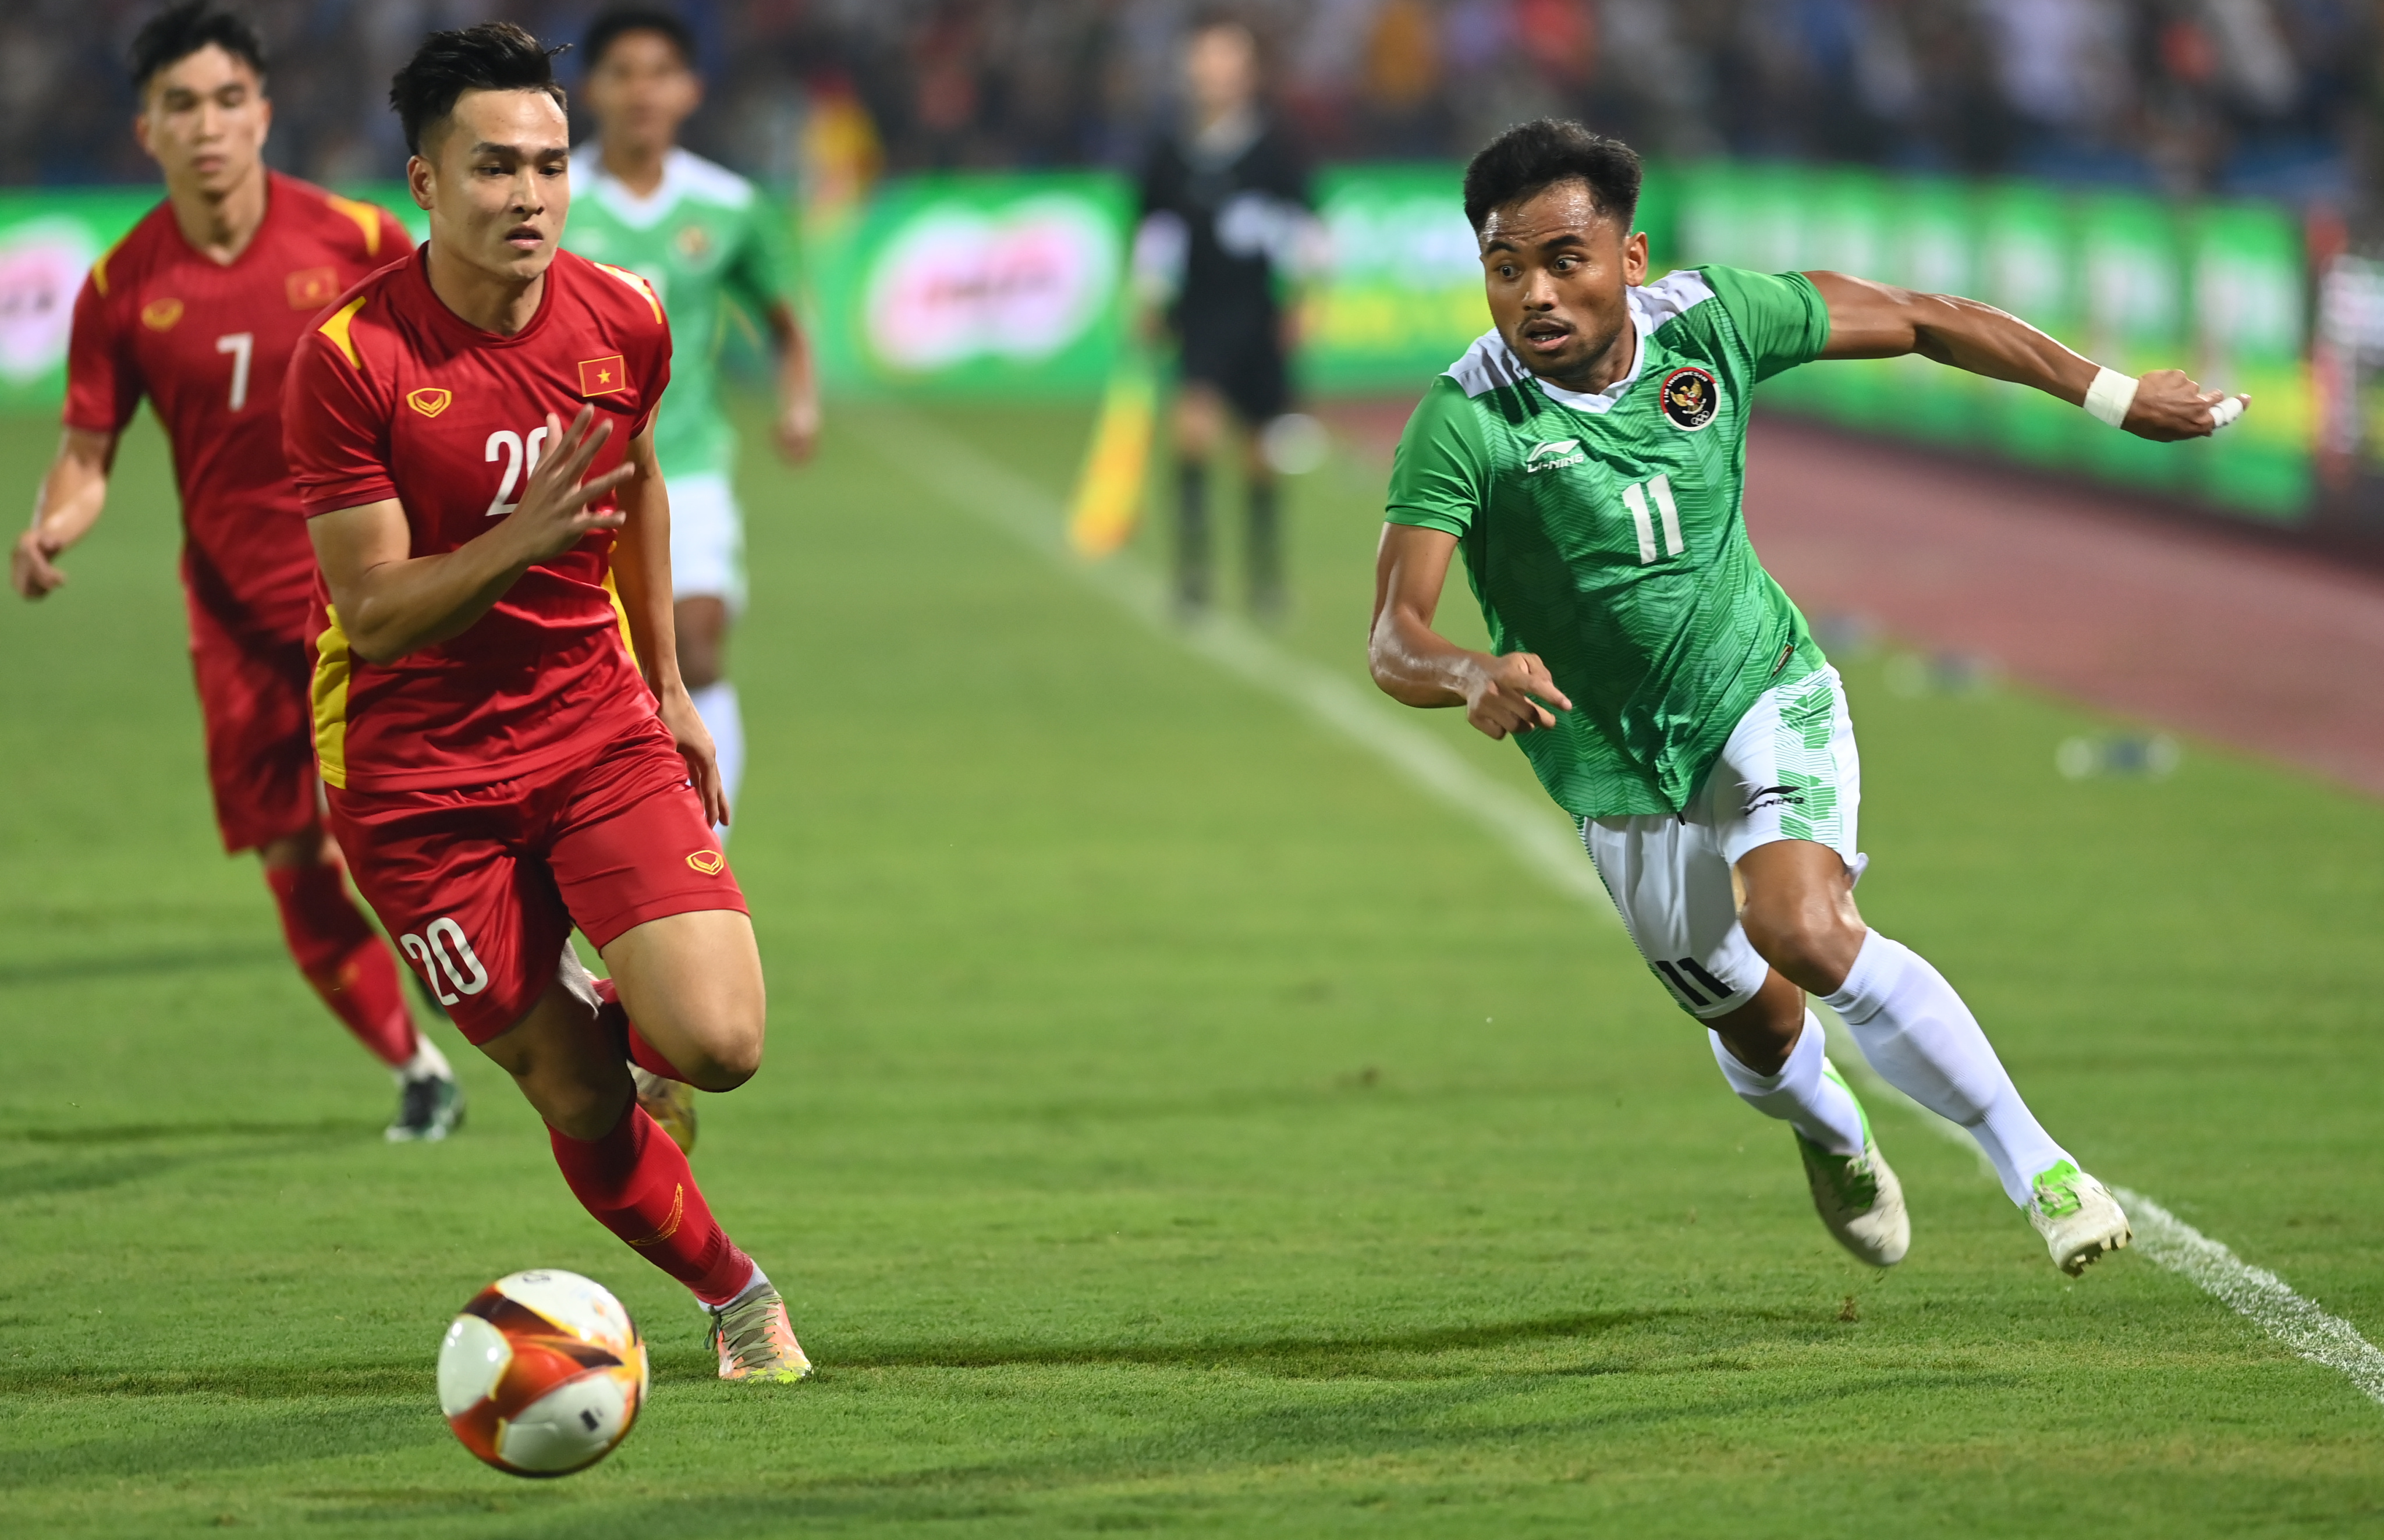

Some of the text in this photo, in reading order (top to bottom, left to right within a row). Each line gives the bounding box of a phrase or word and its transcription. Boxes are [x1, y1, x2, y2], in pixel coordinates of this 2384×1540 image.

[216, 332, 254, 412] 7
[1666, 371, 1708, 386] INDONESIA
[1527, 453, 1584, 473] LI-NING
[1622, 473, 1685, 565] 11
[400, 917, 488, 1006] 20
[1655, 957, 1735, 1006] 11
